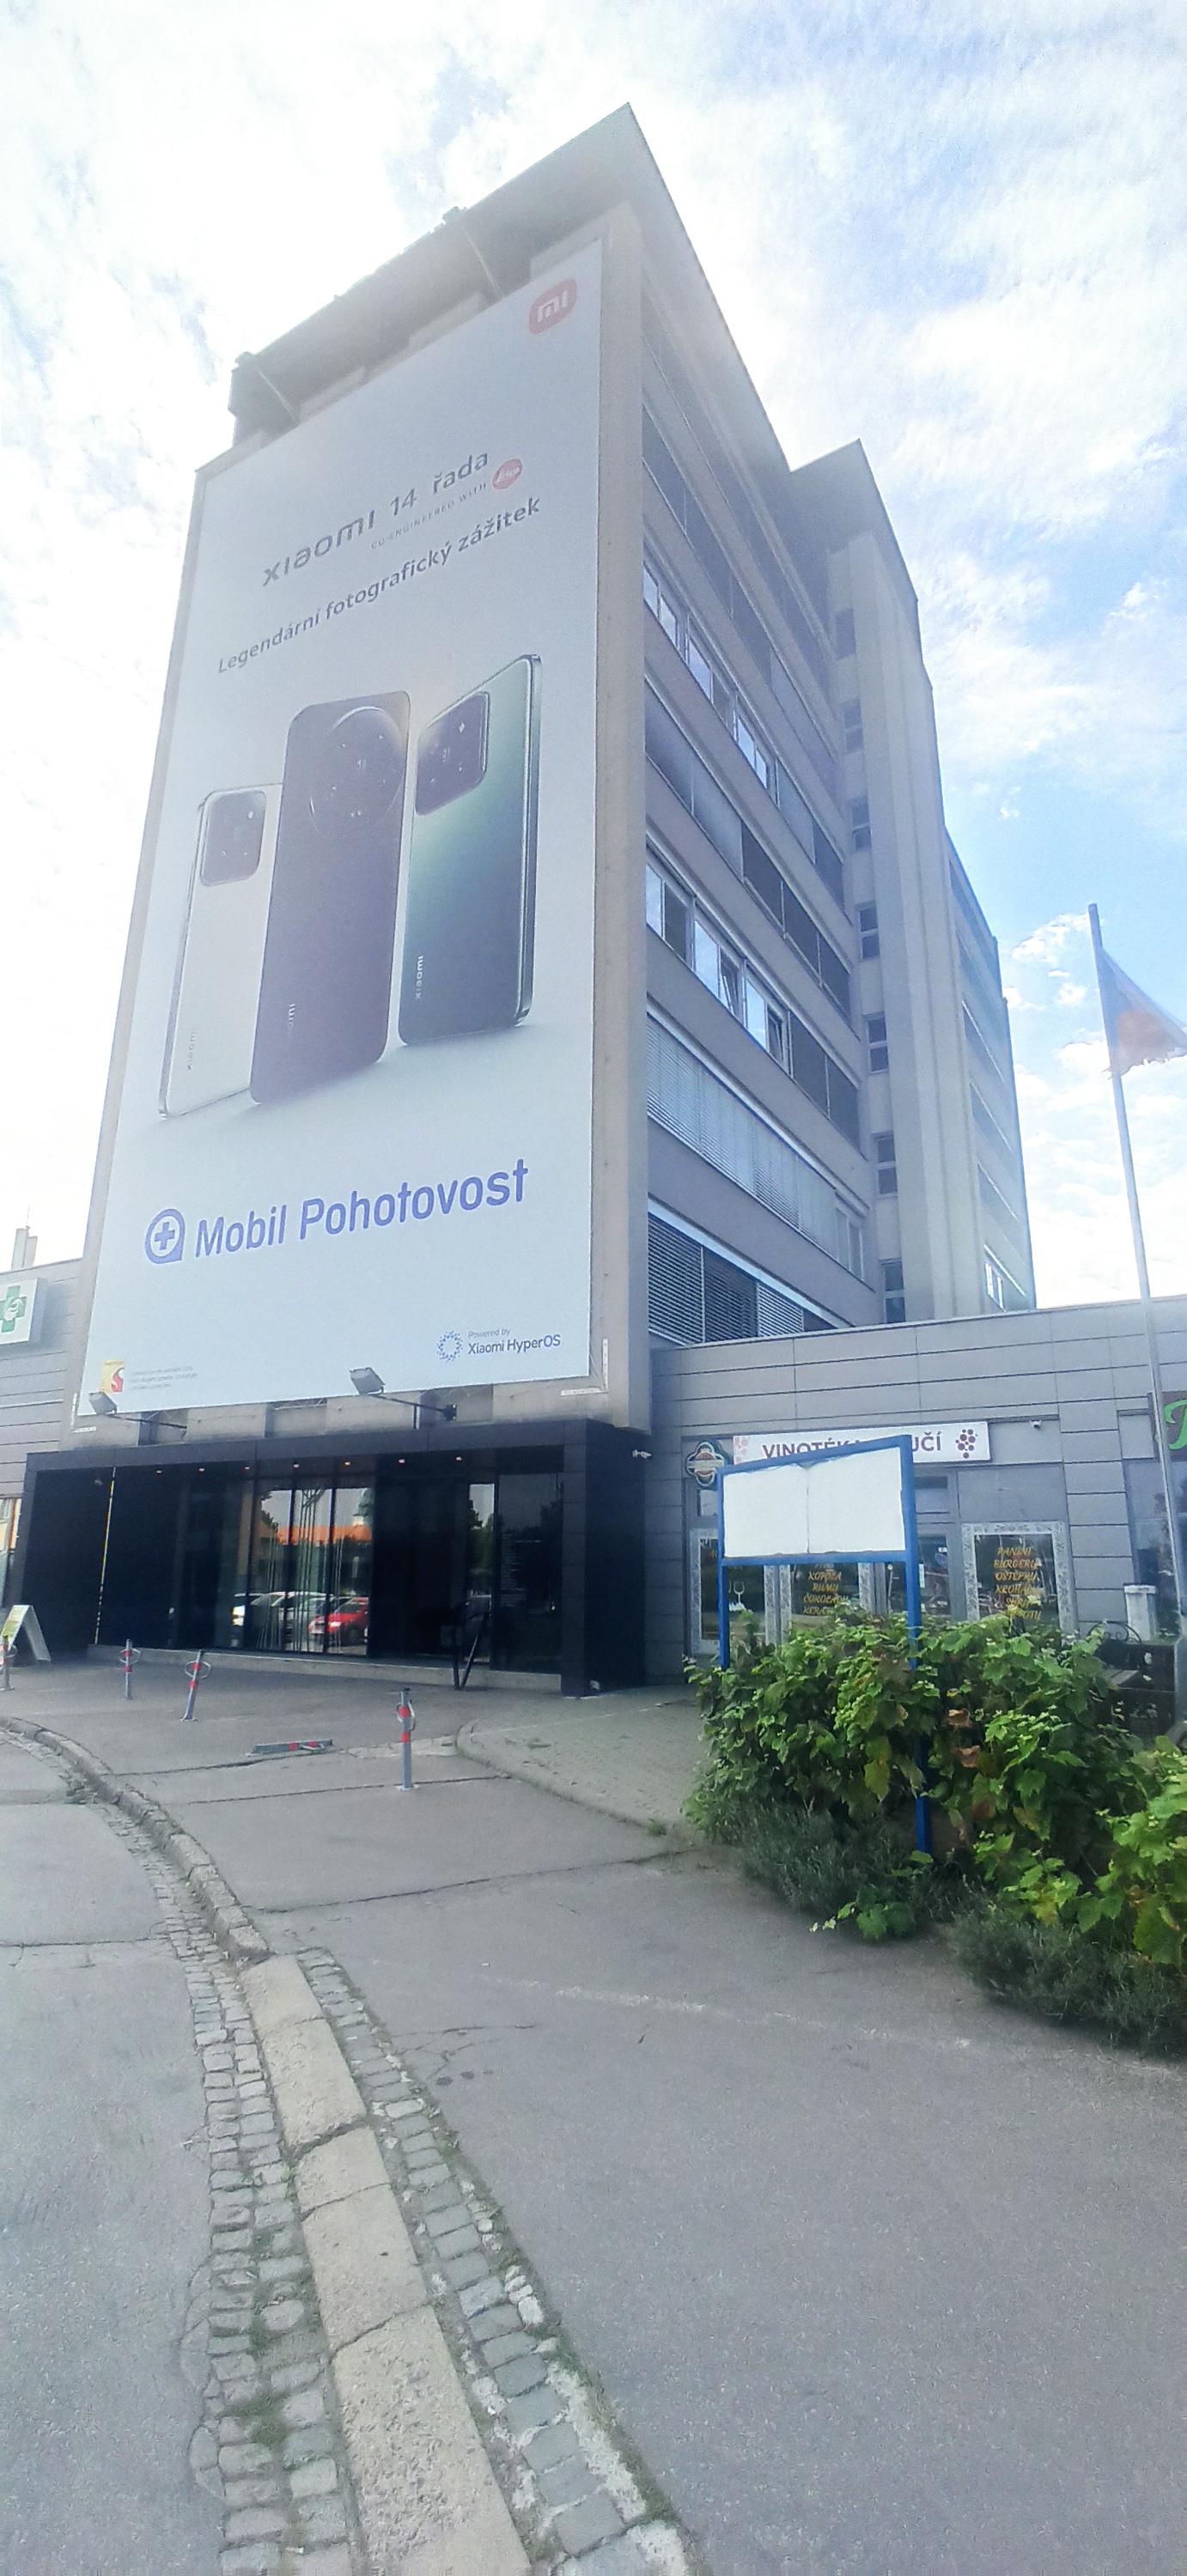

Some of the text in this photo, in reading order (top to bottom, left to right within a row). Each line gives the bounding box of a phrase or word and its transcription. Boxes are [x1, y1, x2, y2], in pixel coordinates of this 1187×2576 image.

[389, 489, 417, 516] 14
[432, 453, 488, 495] řada
[218, 496, 541, 673] Legendární fotografický zážitek
[194, 1158, 529, 1258] Mobil Pohotovost
[468, 1328, 511, 1339] Powered by
[468, 1334, 561, 1355] Xiaomi HyperOS
[762, 1437, 860, 1459] VINOTÉ
